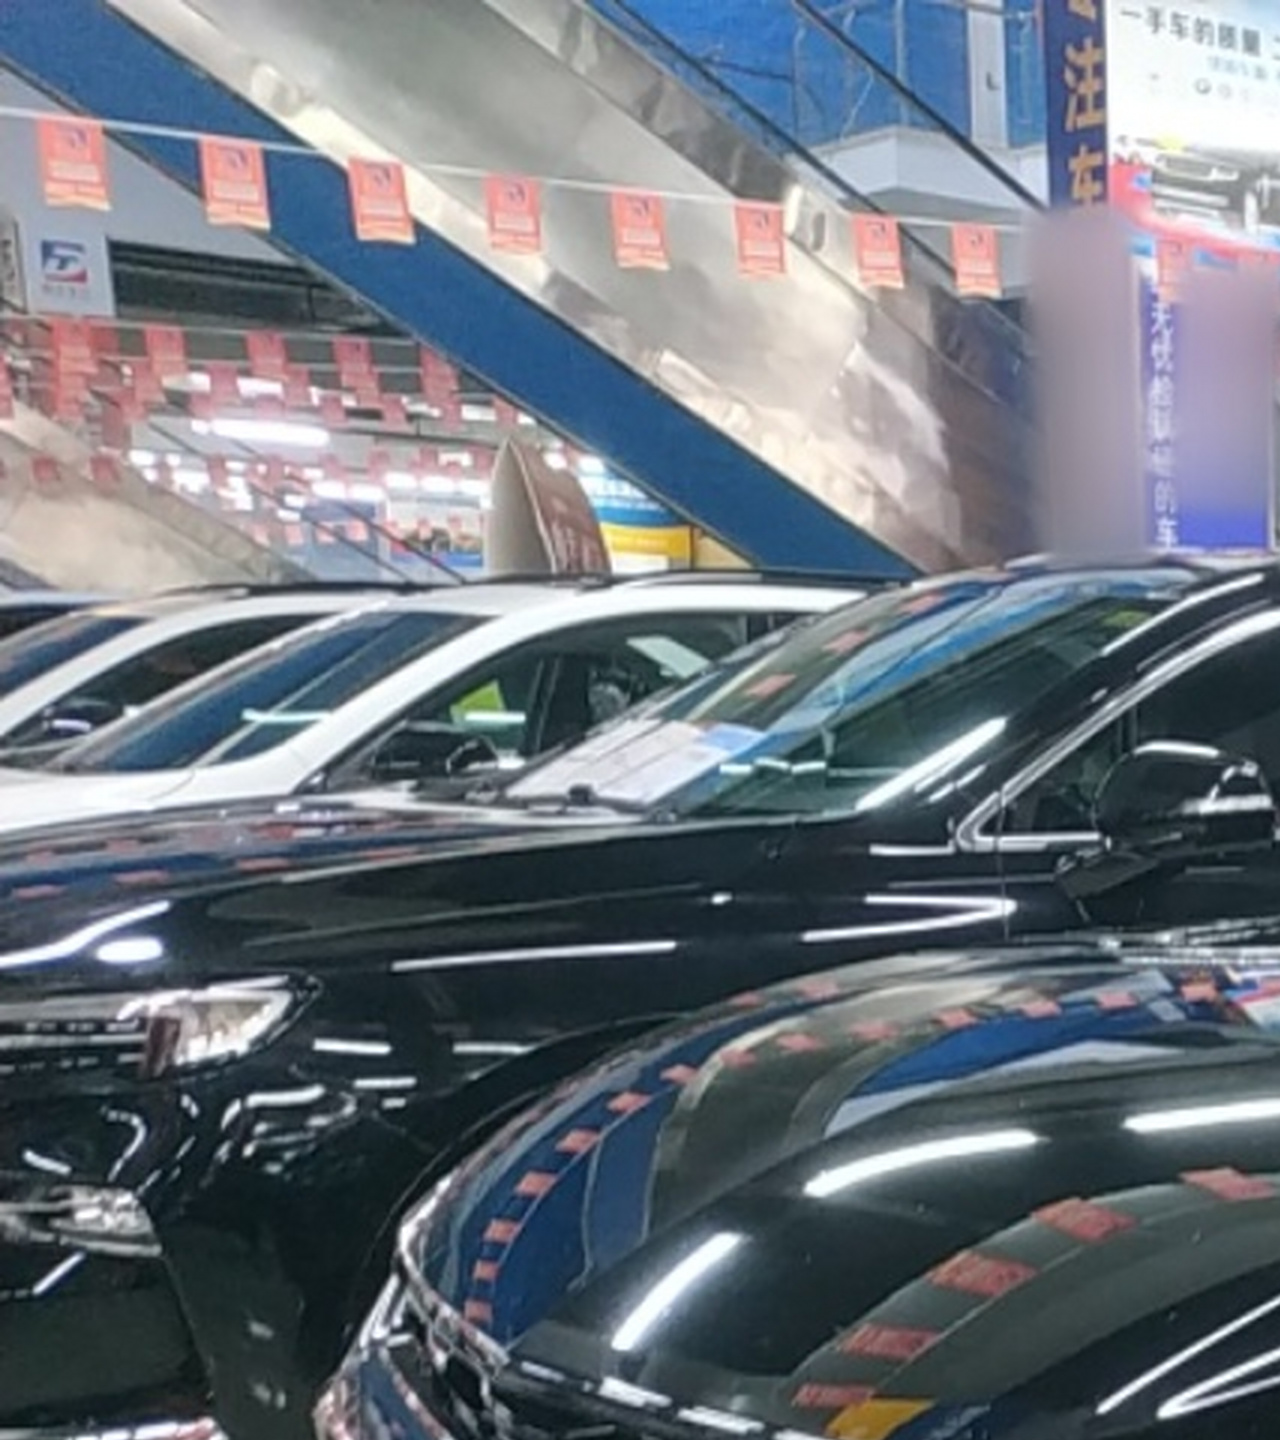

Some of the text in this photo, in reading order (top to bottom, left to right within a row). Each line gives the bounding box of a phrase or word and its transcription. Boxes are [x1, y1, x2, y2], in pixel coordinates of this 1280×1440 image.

[1119, 6, 1261, 57] 一手车的质量
